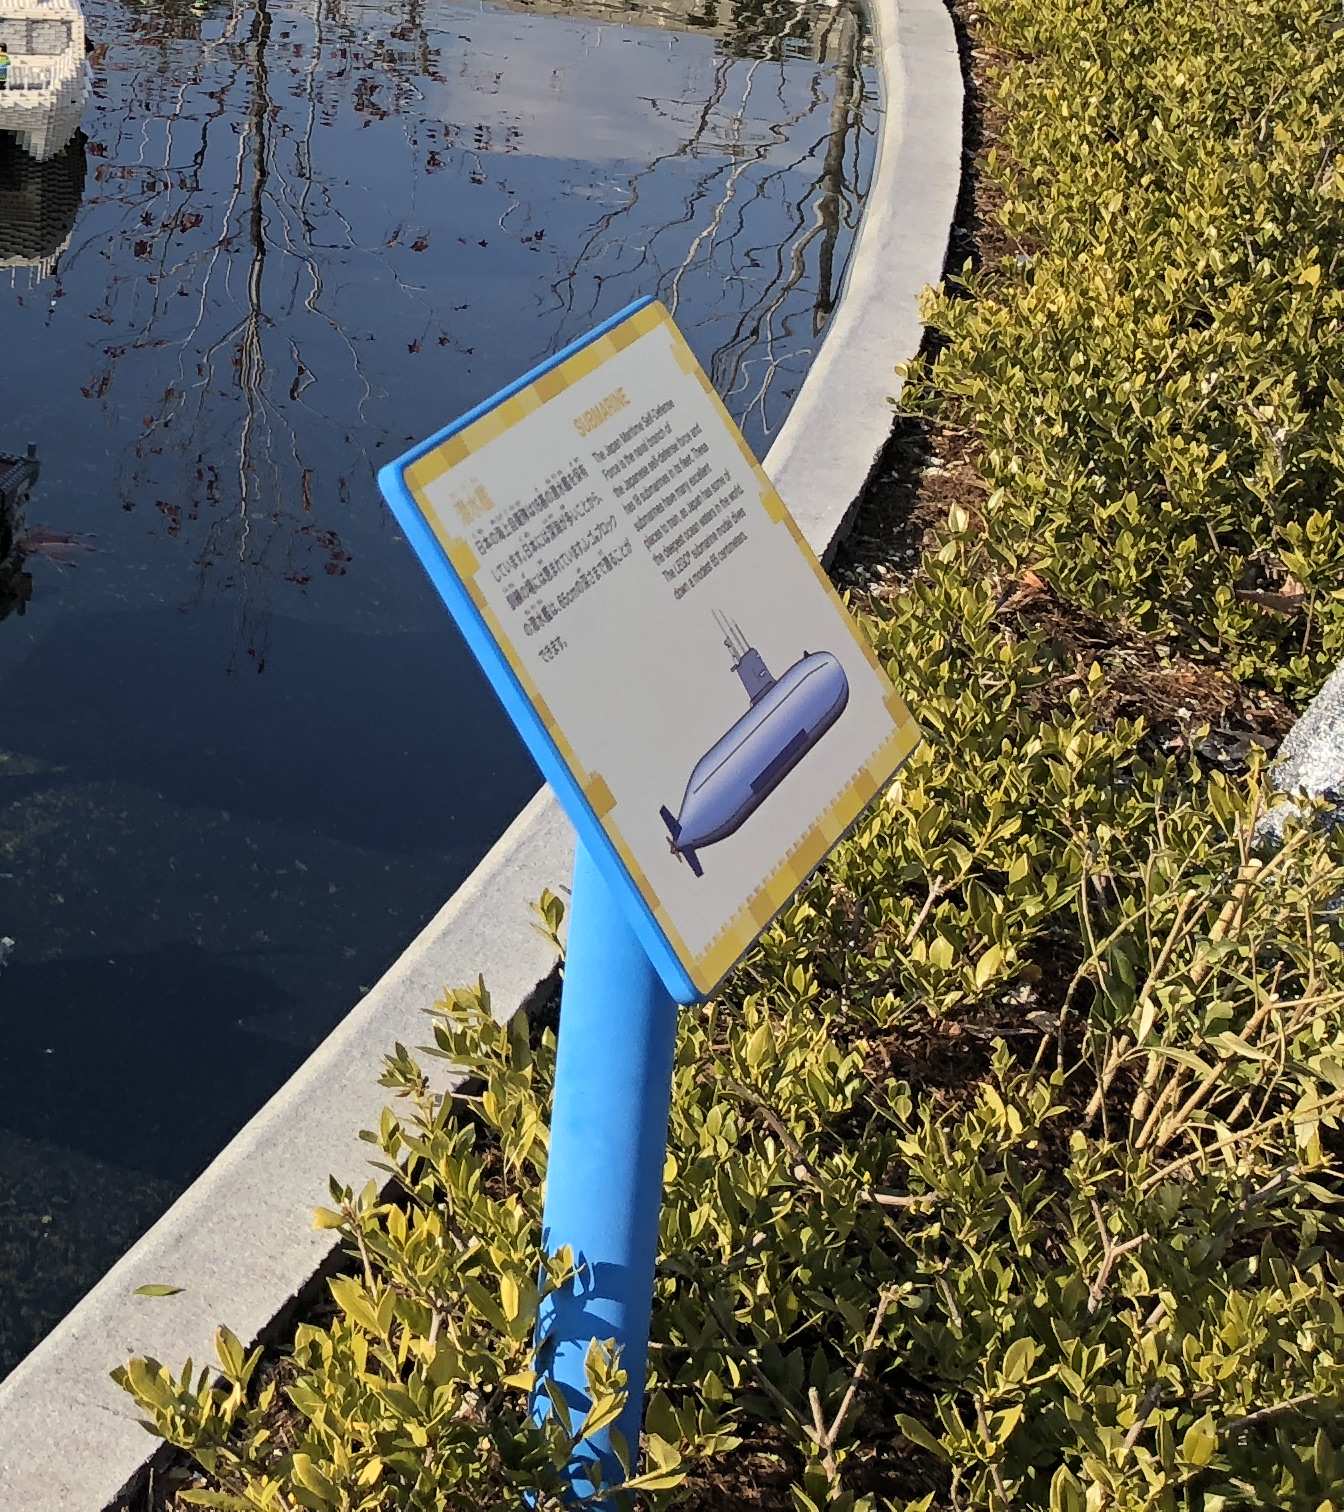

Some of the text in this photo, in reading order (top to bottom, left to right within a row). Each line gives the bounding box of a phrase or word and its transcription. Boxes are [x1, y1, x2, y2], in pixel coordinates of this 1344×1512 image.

[573, 387, 630, 437] SUBMARINE
[591, 450, 606, 463] The
[603, 438, 623, 456] Japan
[618, 421, 644, 443] Maritime
[601, 420, 672, 481] Force is the naval branch of
[612, 421, 702, 498] the Japanese self-defense force and
[621, 500, 636, 514] has
[639, 473, 670, 502] submarines
[666, 468, 676, 479] in
[690, 442, 709, 459] These
[633, 462, 712, 532] submarines have many excellent
[643, 528, 663, 552] places
[659, 523, 669, 534] to
[679, 507, 688, 519] as
[685, 494, 703, 513] Japan
[699, 486, 713, 500] has
[710, 475, 726, 492] some
[723, 467, 731, 481] of
[652, 552, 665, 566] the
[662, 533, 686, 558] deepest
[682, 521, 701, 540] ocean
[698, 507, 717, 527] waters
[712, 503, 722, 513] in
[718, 496, 730, 509] the
[661, 568, 676, 582] The
[690, 531, 718, 559] submarine
[715, 515, 733, 537] model
[730, 507, 746, 523] dives
[673, 581, 690, 600] down
[687, 577, 695, 588] a
[691, 560, 713, 584] modest
